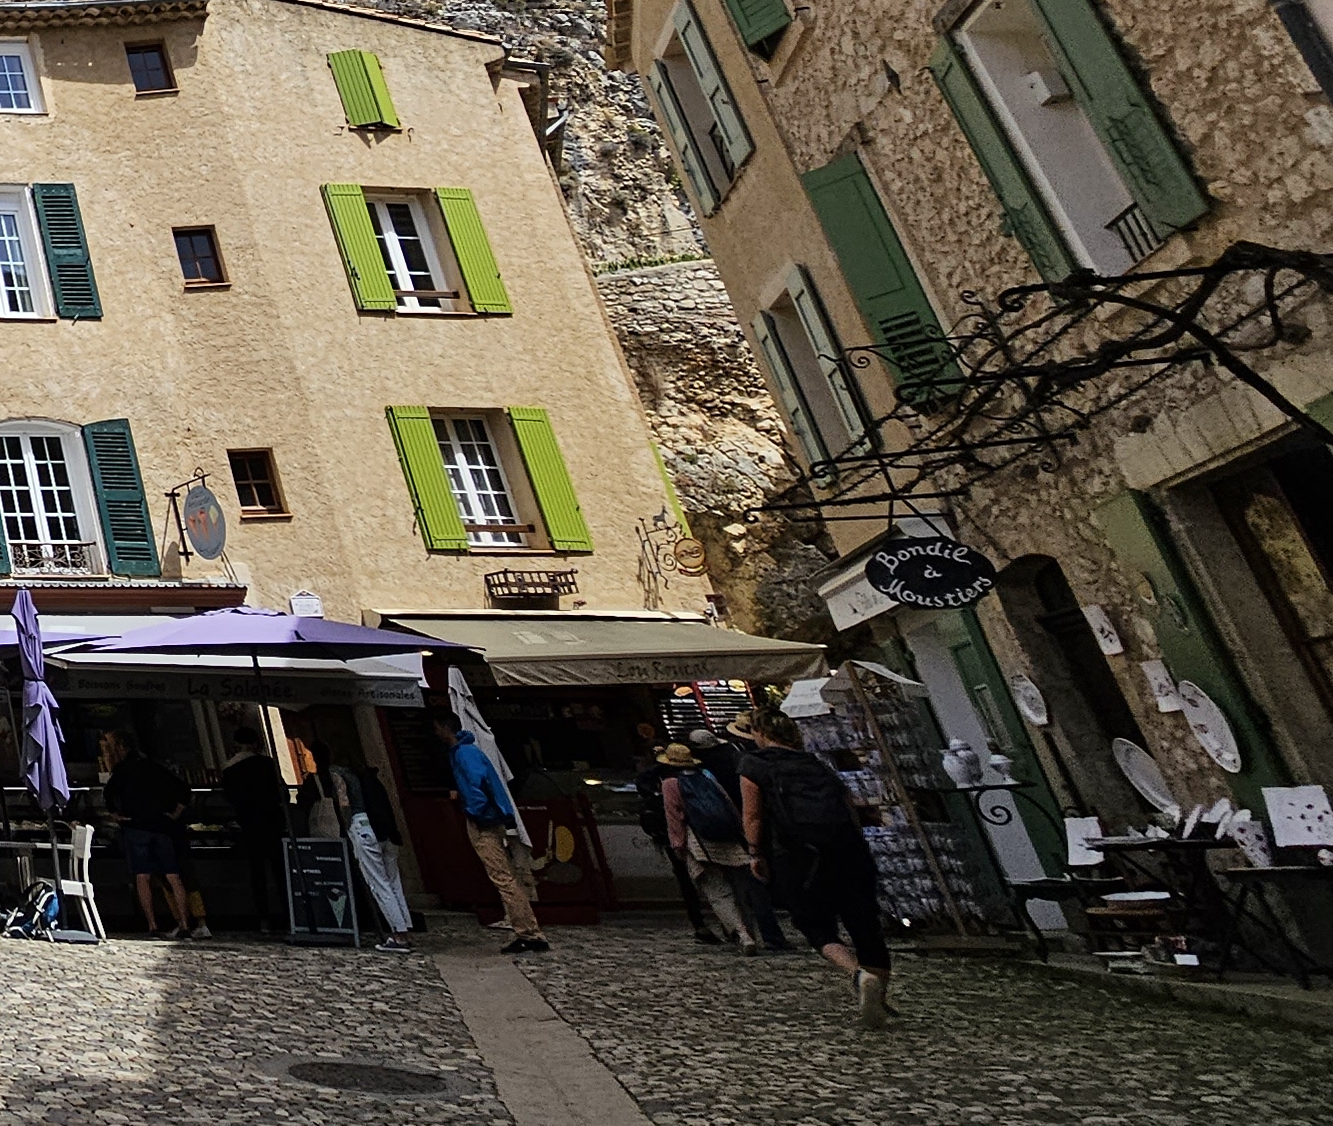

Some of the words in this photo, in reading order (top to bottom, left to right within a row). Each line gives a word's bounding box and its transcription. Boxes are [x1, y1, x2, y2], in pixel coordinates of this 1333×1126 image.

[876, 542, 972, 575] Bondil
[924, 564, 943, 579] à
[879, 576, 992, 608] Moustiers
[187, 678, 210, 696] La
